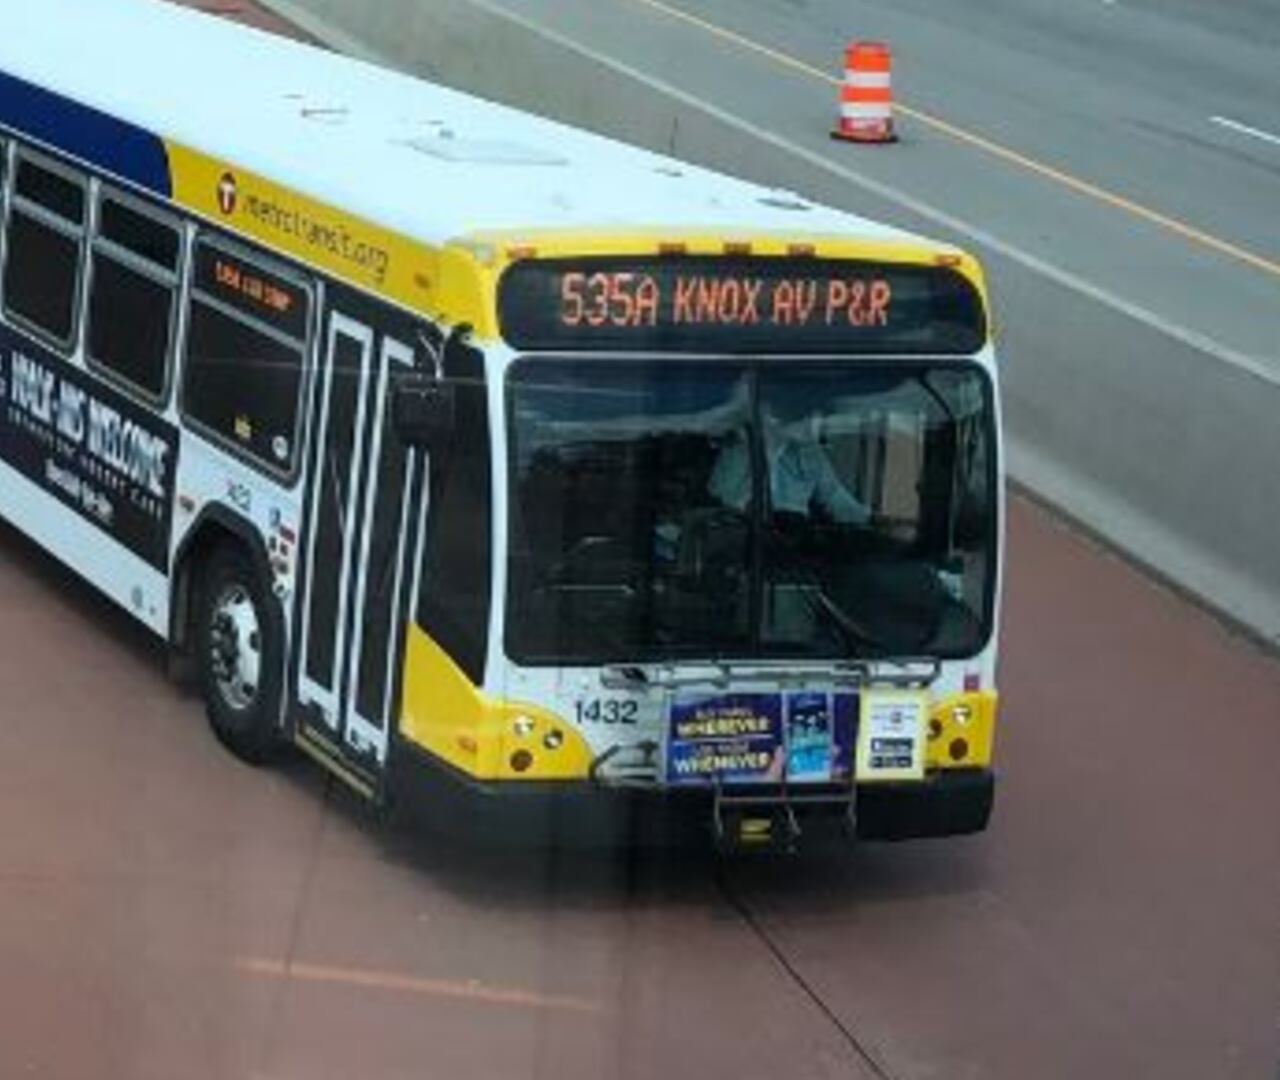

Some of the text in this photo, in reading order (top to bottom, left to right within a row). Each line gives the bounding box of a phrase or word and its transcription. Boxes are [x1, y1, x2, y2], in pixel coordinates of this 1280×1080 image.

[560, 272, 892, 326] 535A KNOX AV P&R
[88, 394, 170, 498] WELCOME
[575, 698, 639, 725] 1432
